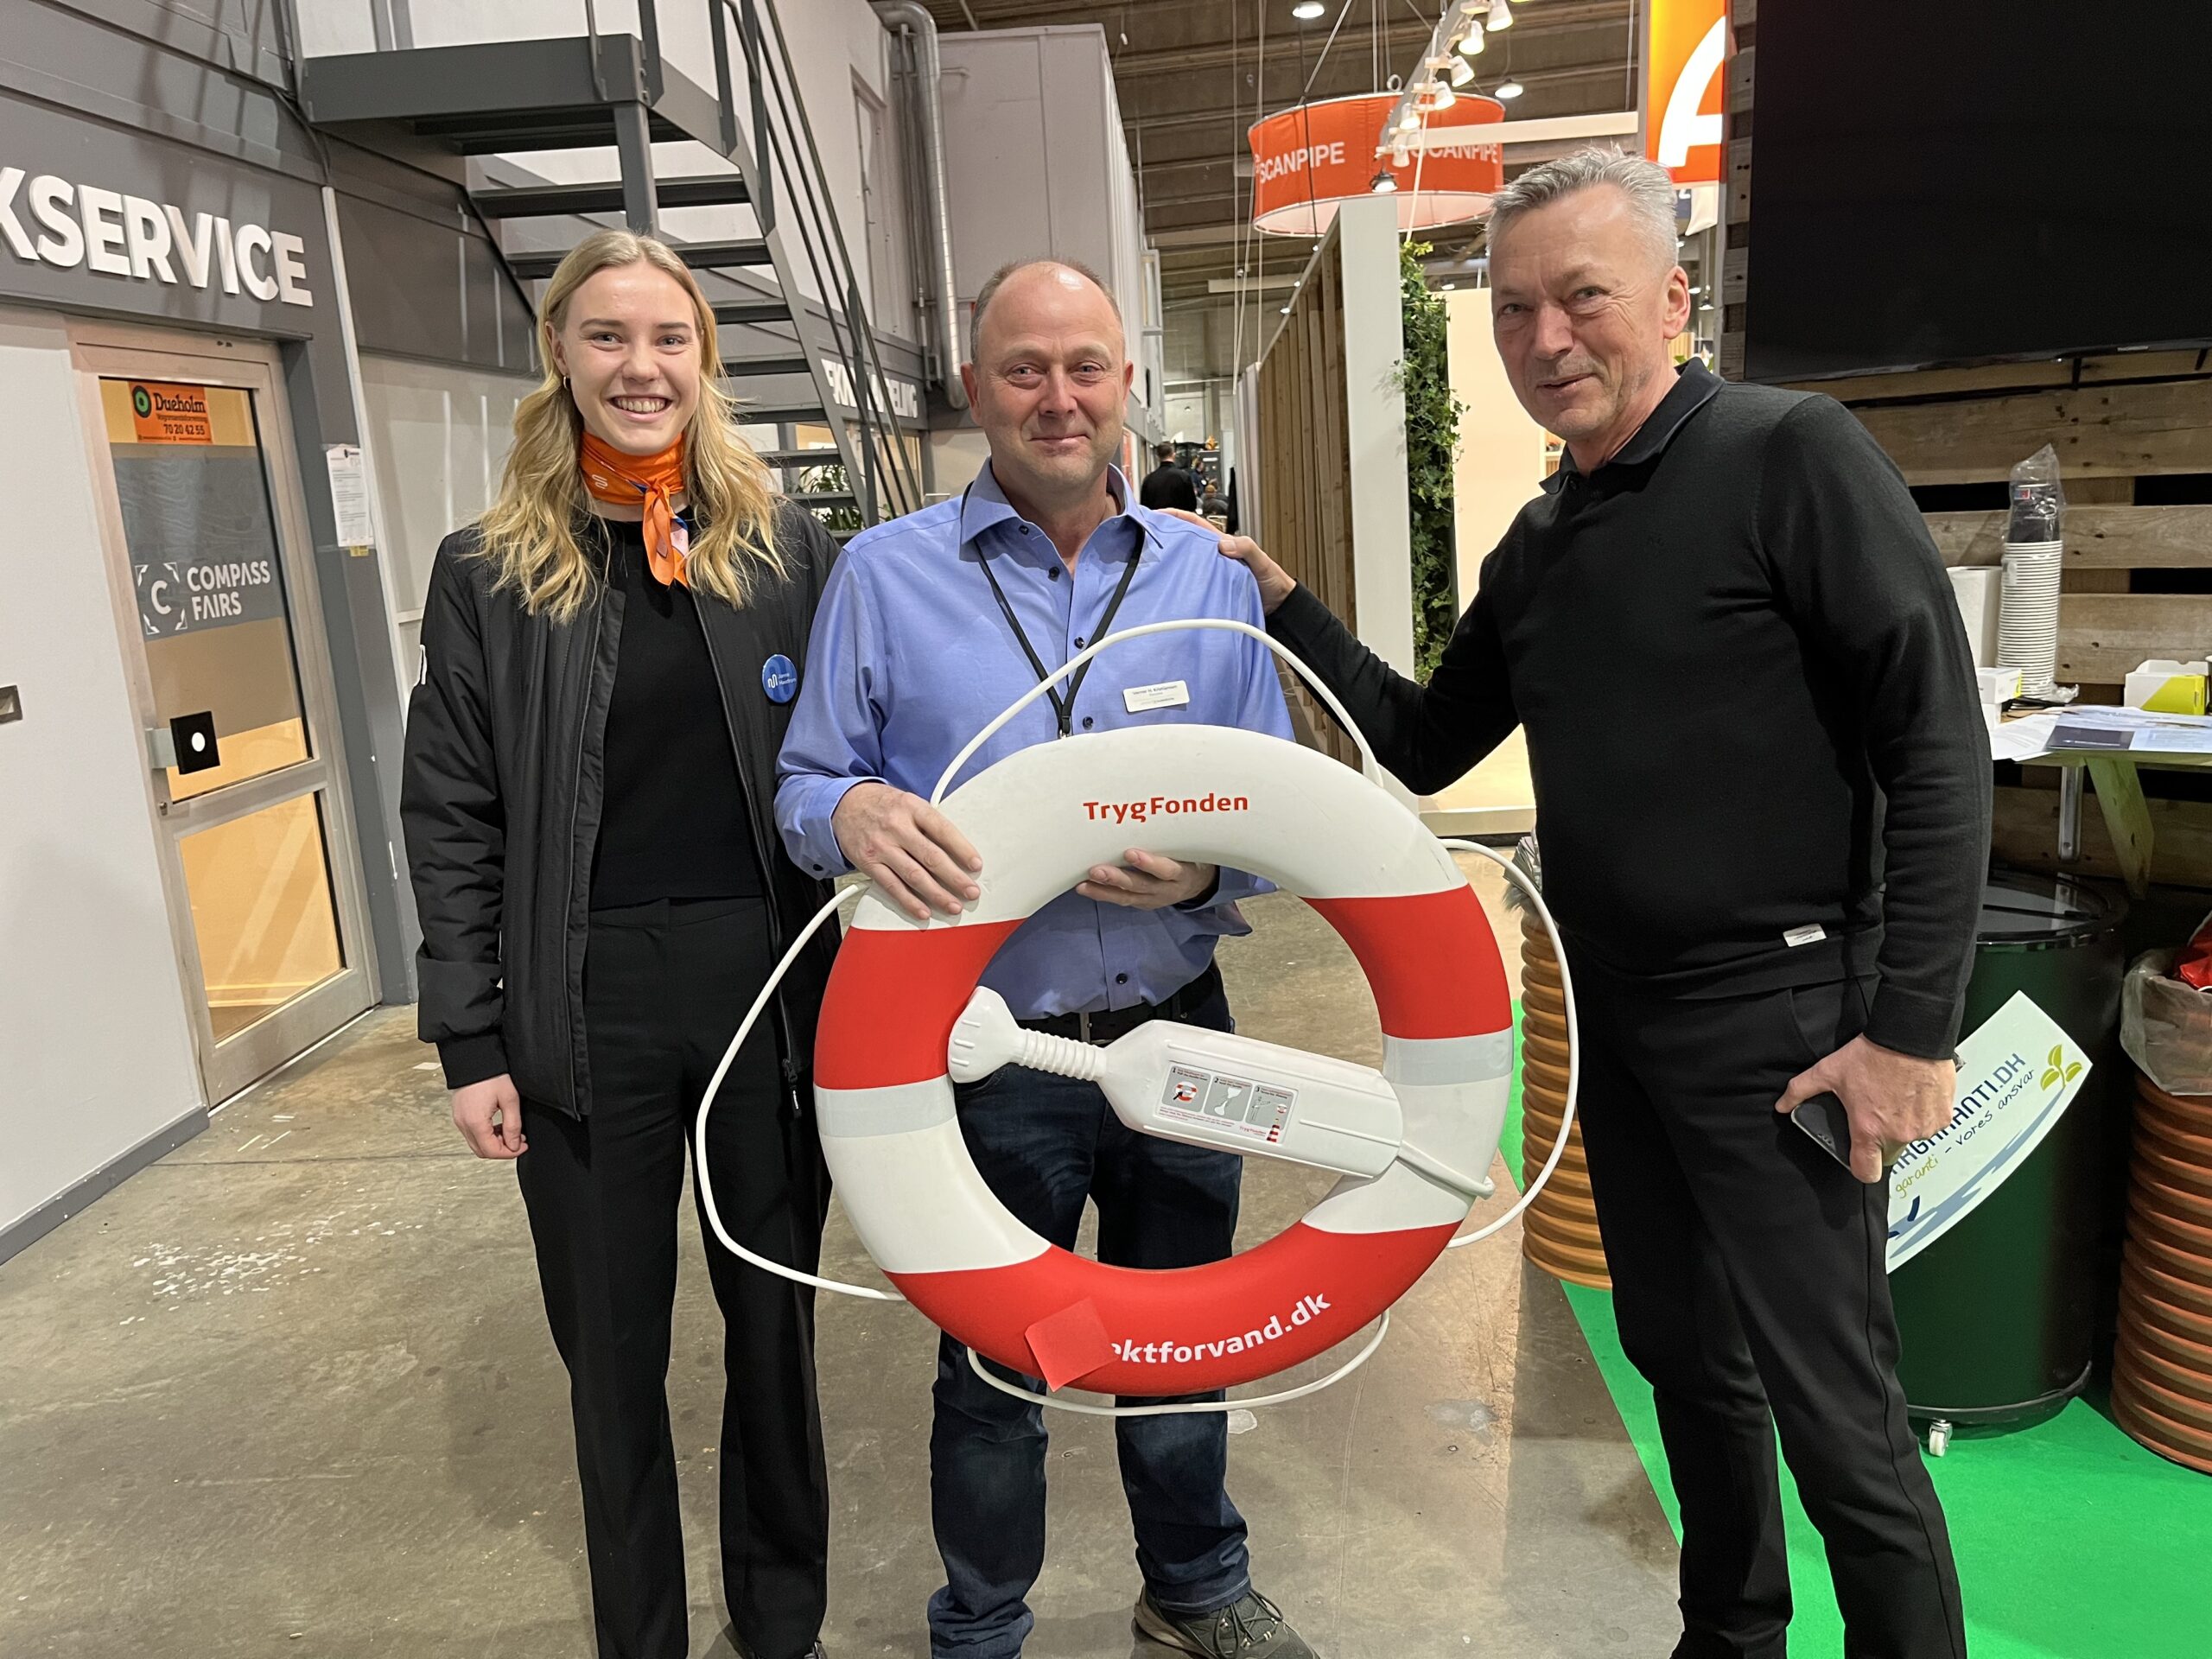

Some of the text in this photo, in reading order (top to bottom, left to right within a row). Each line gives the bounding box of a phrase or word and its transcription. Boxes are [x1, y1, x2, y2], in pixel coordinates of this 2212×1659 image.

[1259, 142, 1345, 184] SCANPIPE
[153, 392, 207, 414] Dueholm
[187, 560, 270, 592] COMPASS
[192, 591, 242, 621] FAIRS
[1083, 792, 1249, 824] TrygFonden
[1895, 1154, 1939, 1199] garanti
[1955, 1110, 1993, 1146] vores
[1998, 1070, 2035, 1110] ansvar
